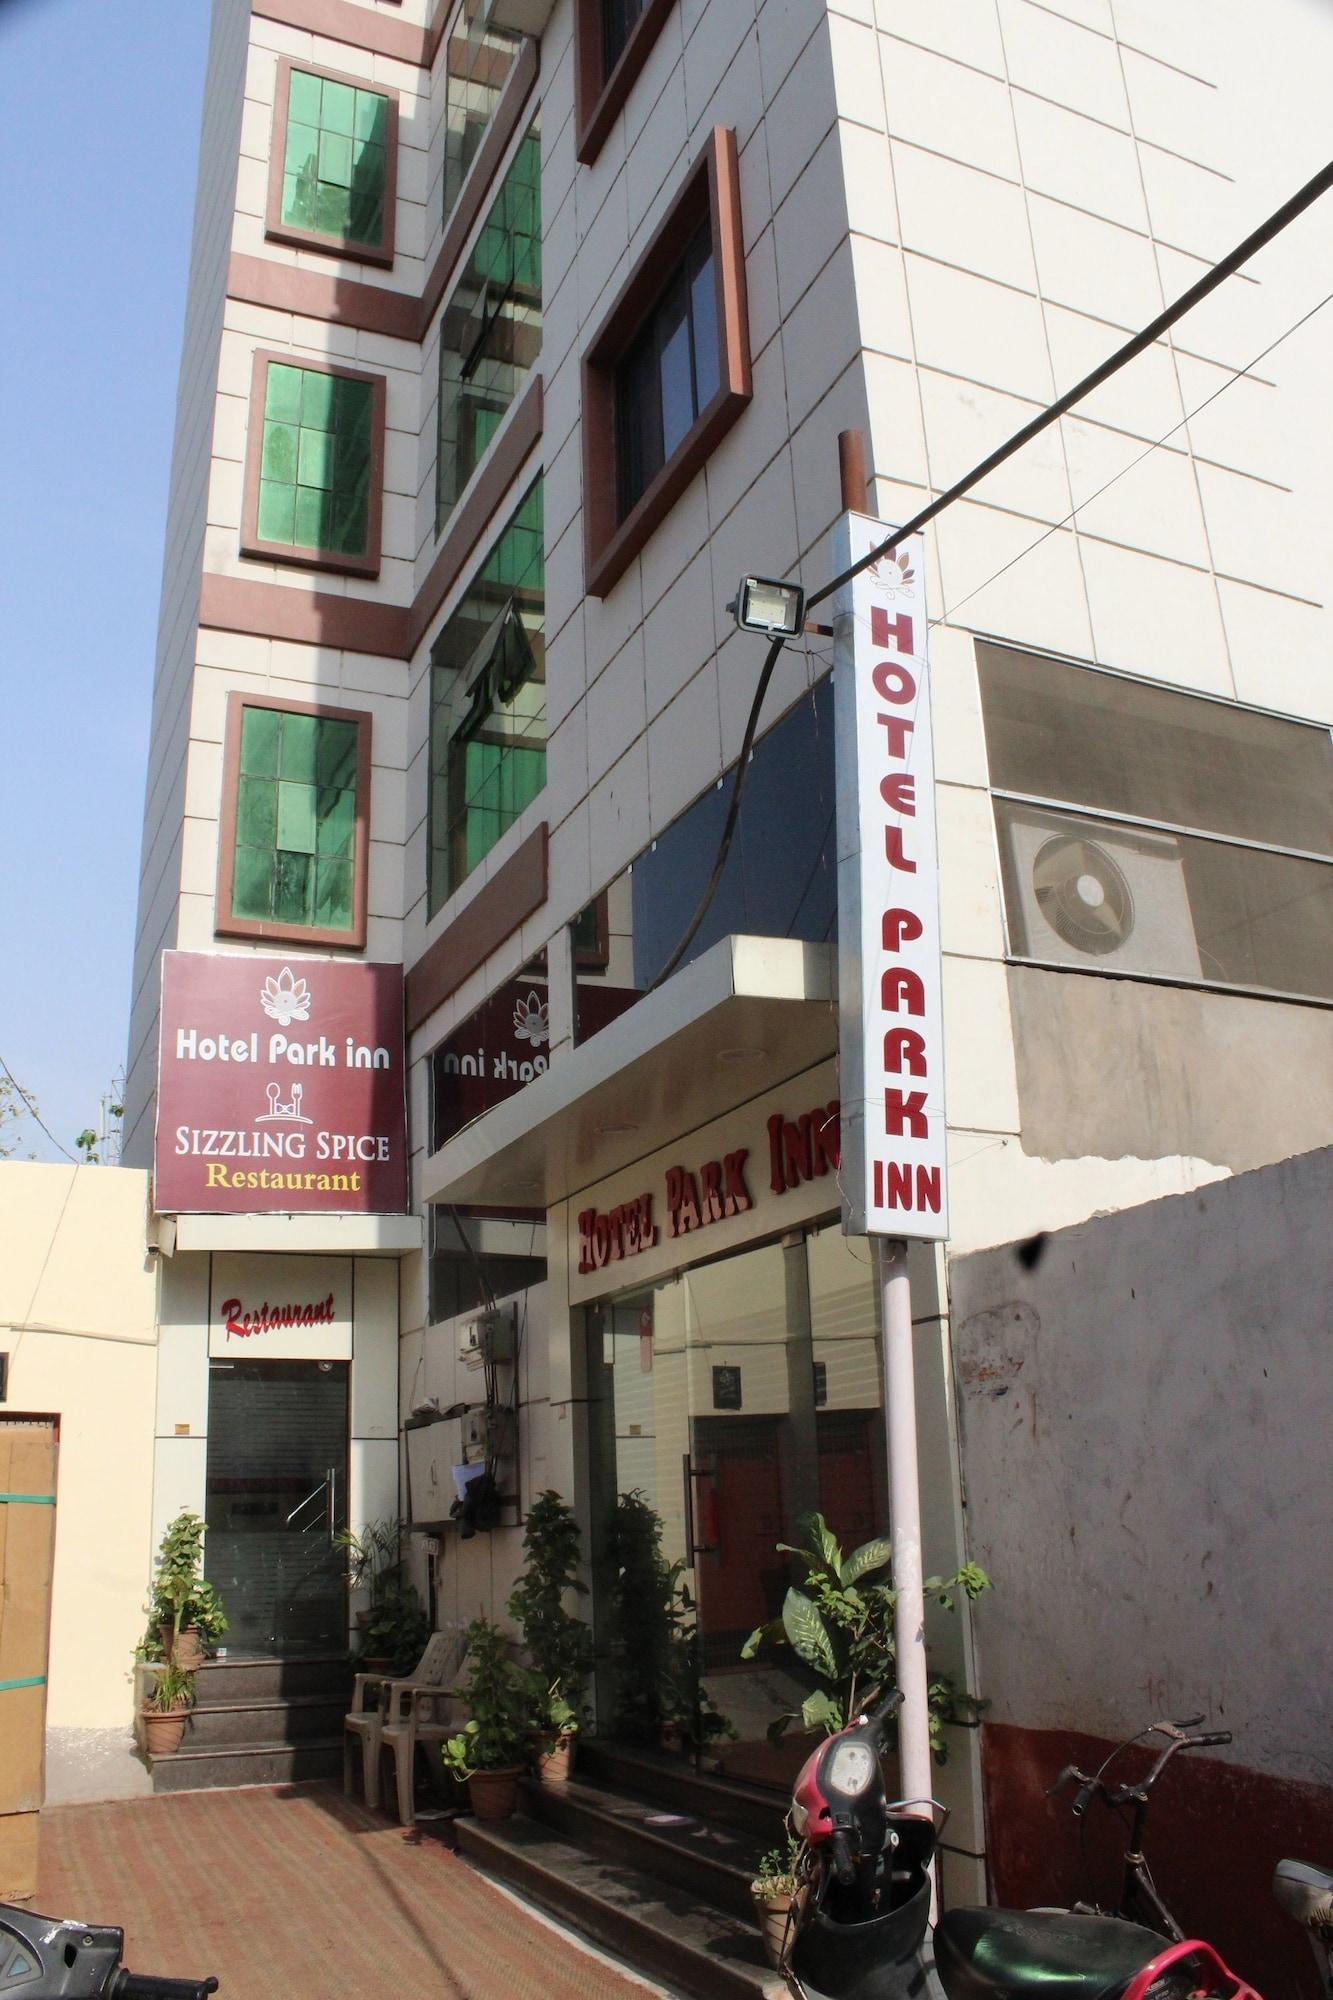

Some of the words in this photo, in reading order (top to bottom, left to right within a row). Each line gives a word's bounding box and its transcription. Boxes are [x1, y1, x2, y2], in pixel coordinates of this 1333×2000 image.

[870, 605, 917, 874] HOTEL
[176, 1028, 258, 1063] Hotel
[268, 1033, 336, 1067] Park
[346, 1038, 390, 1070] inn
[881, 907, 929, 1140] PARK
[175, 1125, 306, 1160] SIZZLING
[316, 1131, 390, 1162] SPICE
[205, 1162, 361, 1192] Restaurant
[578, 1193, 658, 1274] HOTEL
[665, 1149, 753, 1238] PARK
[767, 1100, 841, 1195] INN
[873, 1160, 942, 1214] INN
[221, 1292, 335, 1342] Restaurant
